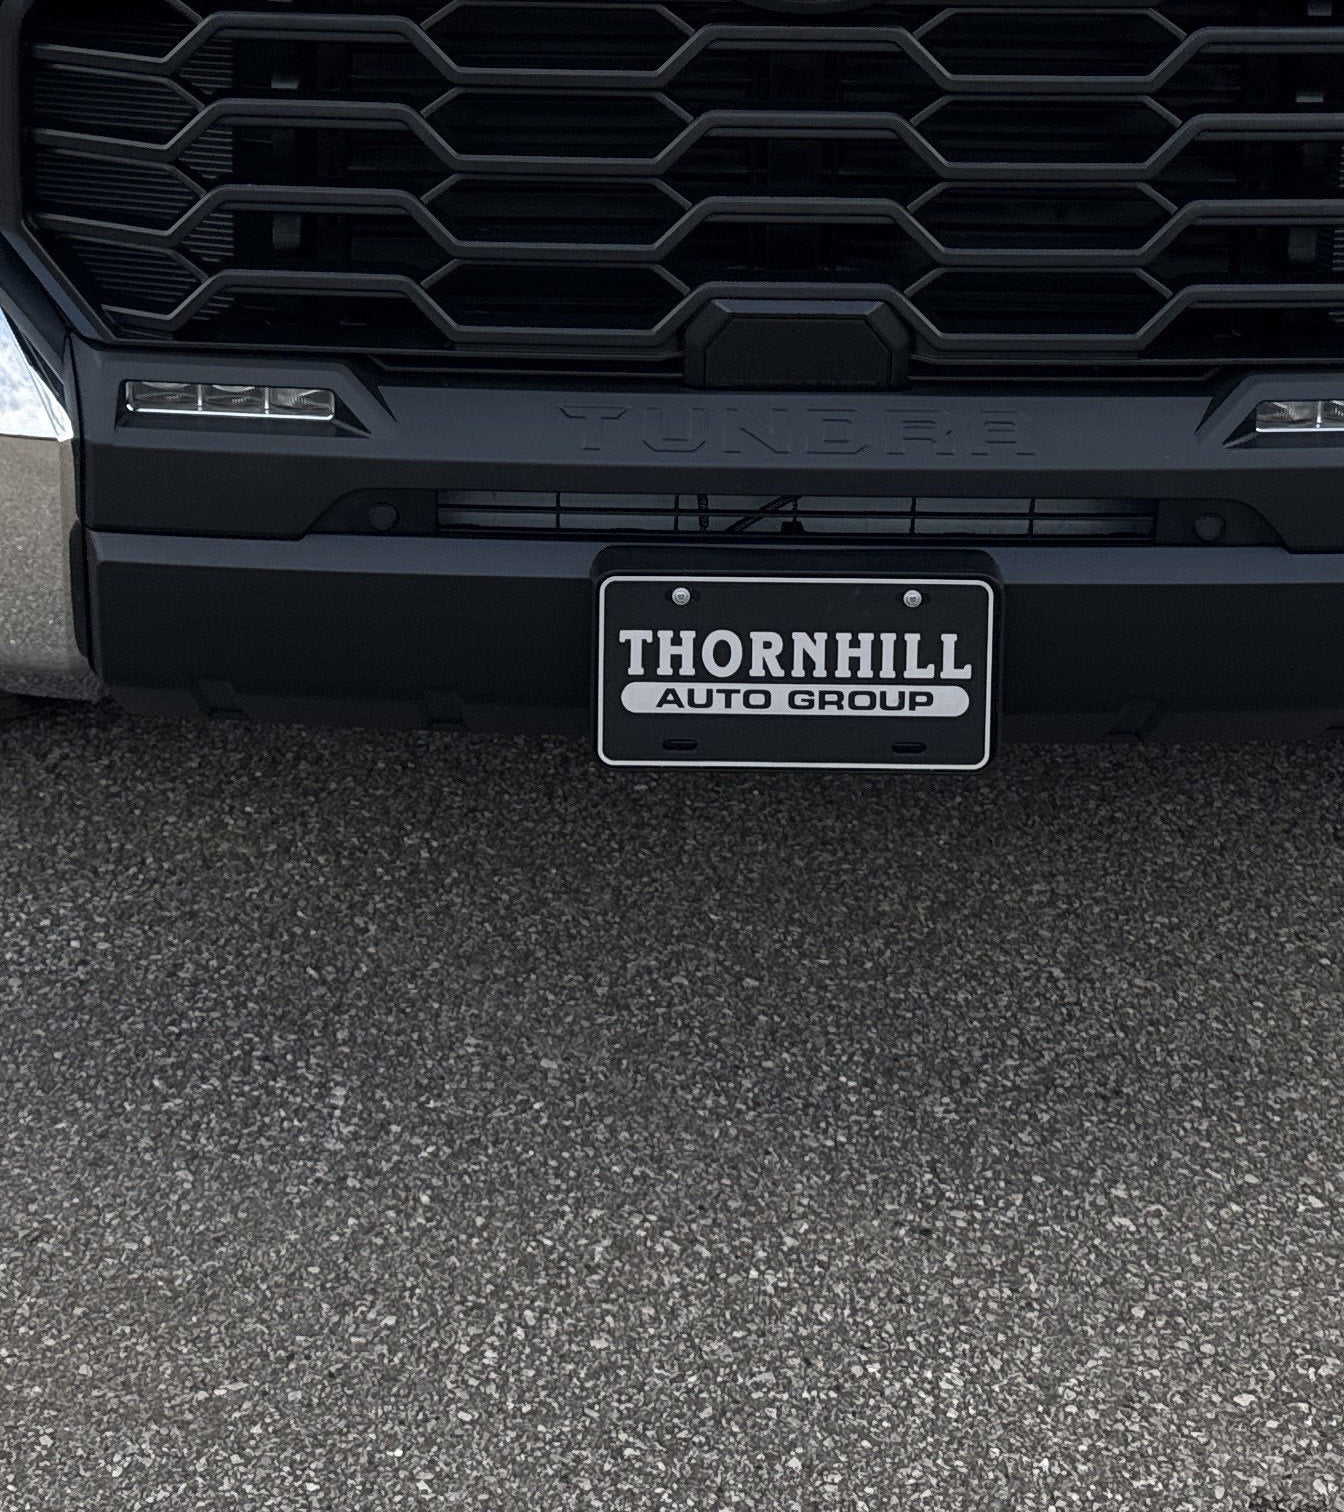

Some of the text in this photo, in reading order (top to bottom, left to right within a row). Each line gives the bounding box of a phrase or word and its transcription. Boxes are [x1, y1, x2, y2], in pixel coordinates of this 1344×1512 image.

[557, 405, 1038, 458] TUNDRA
[619, 629, 973, 680] THORNHILL
[655, 688, 934, 712] AUTO GROUP
